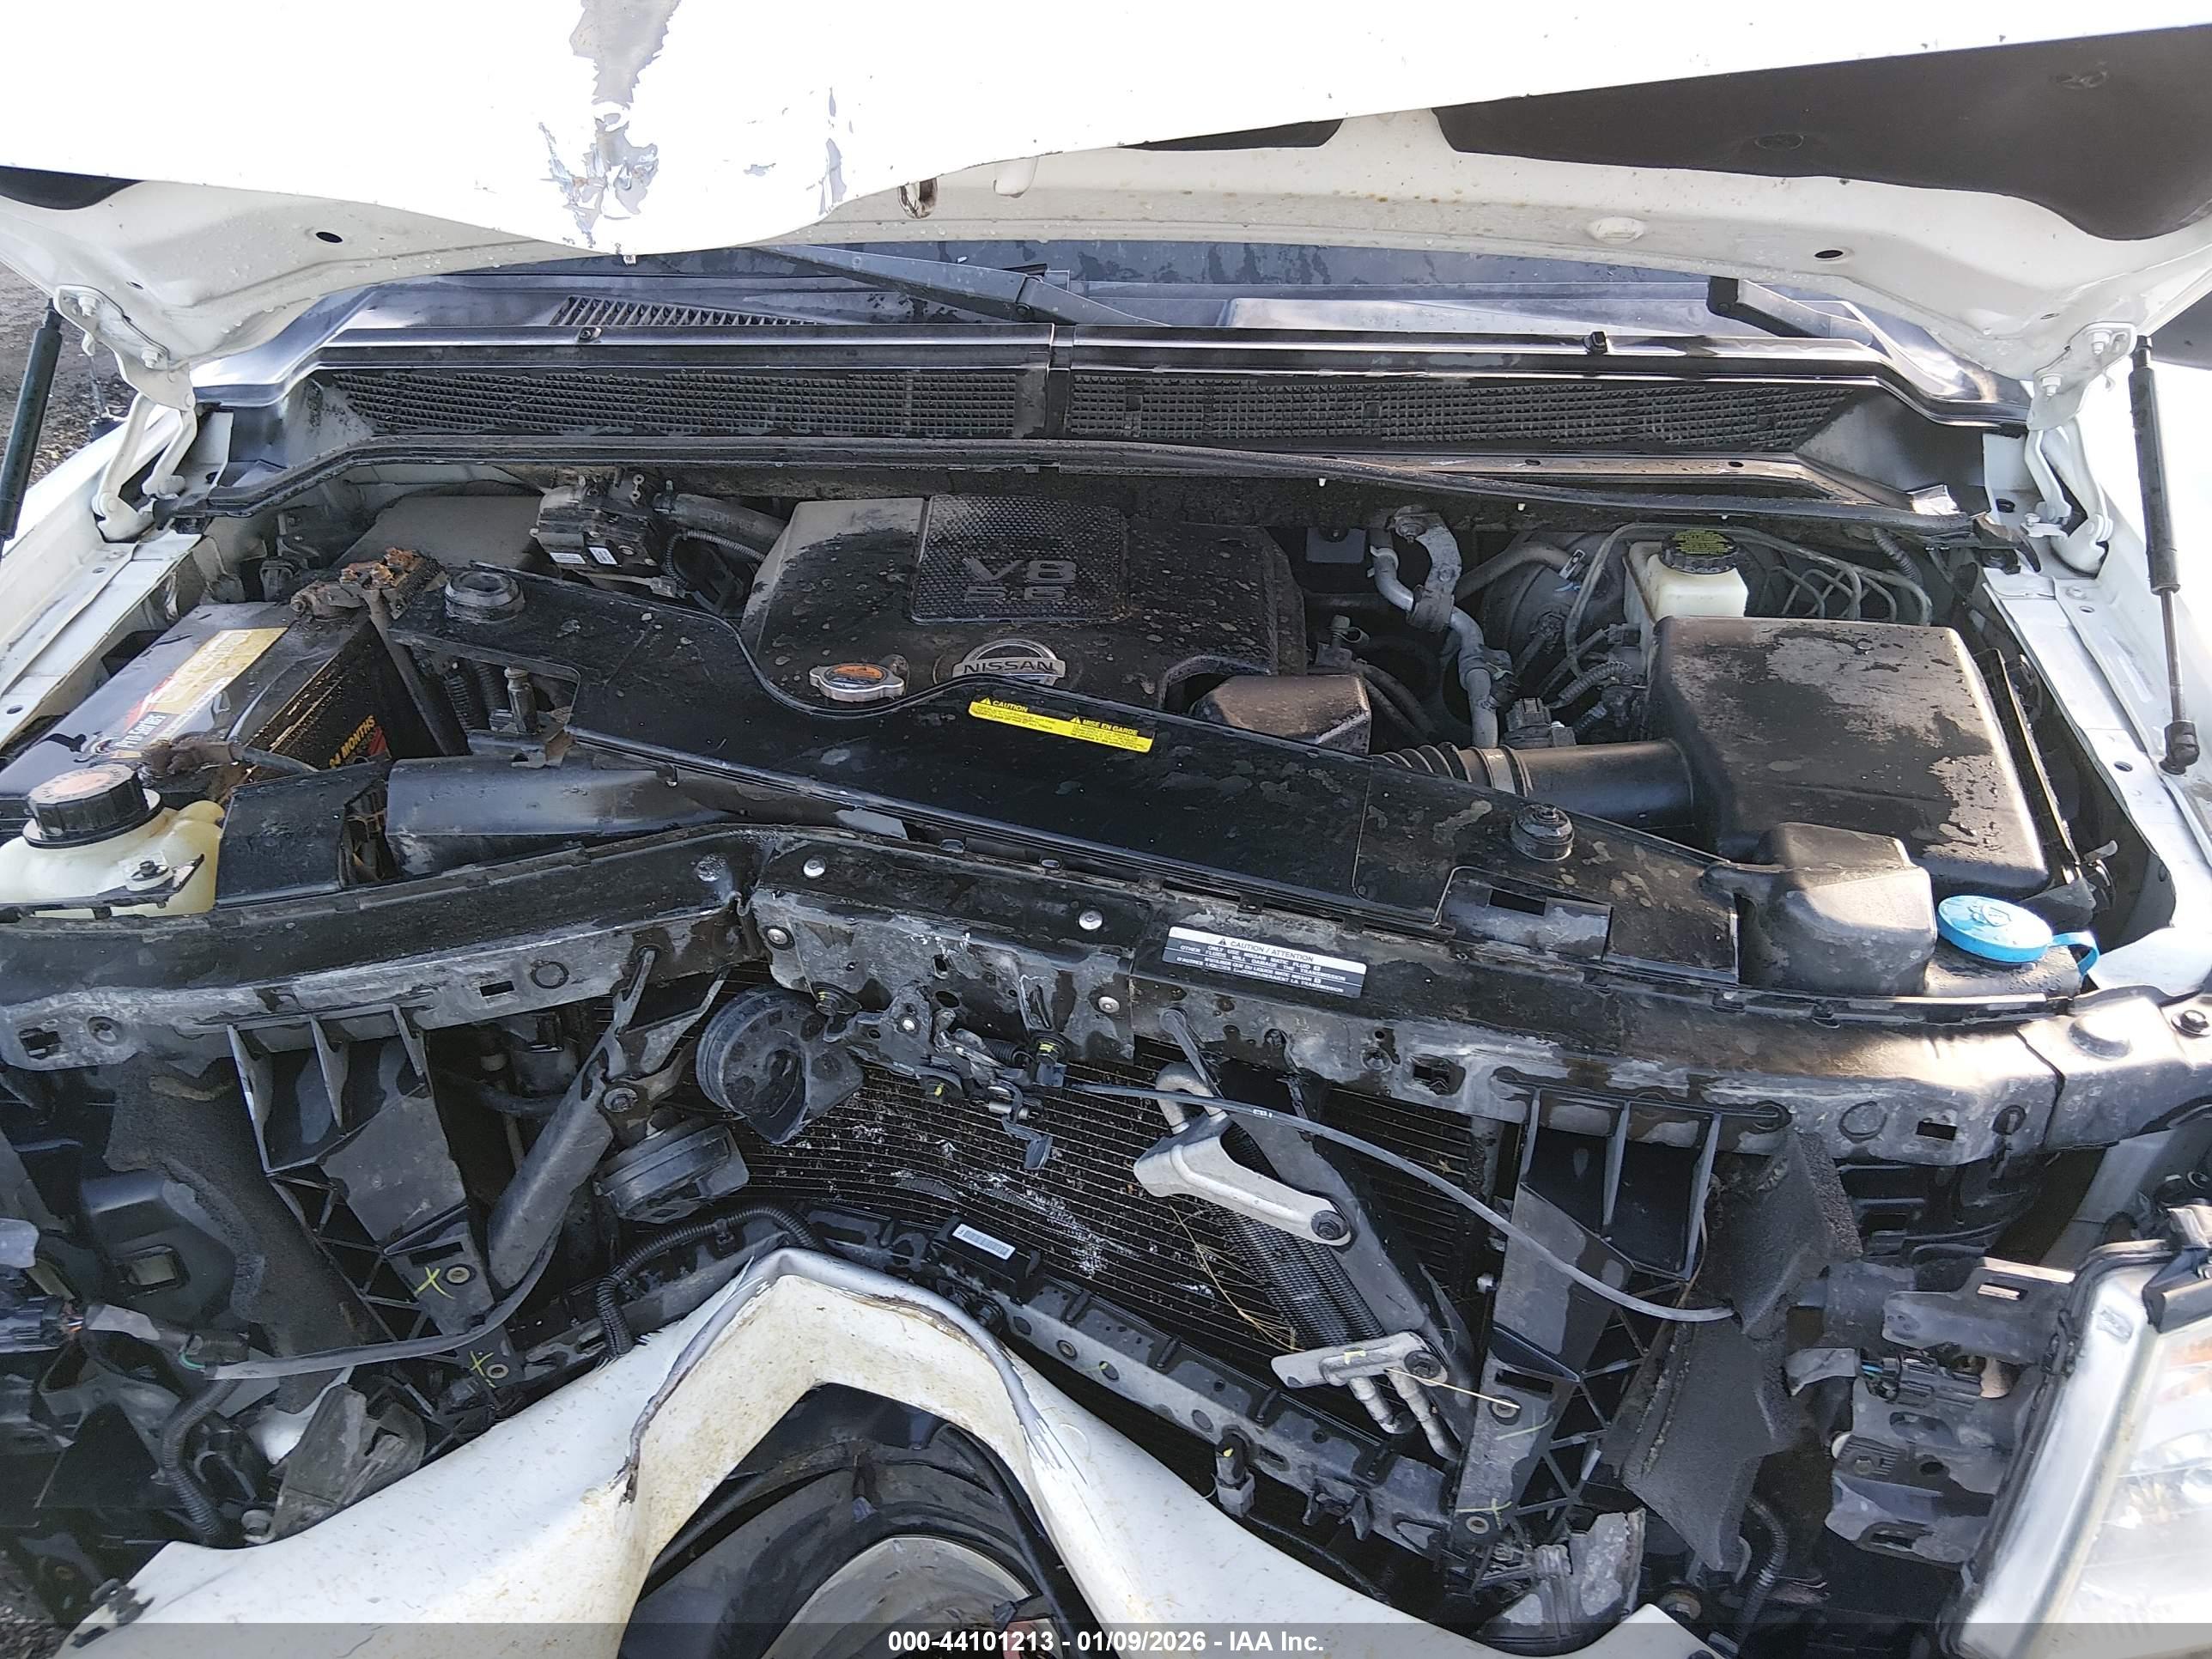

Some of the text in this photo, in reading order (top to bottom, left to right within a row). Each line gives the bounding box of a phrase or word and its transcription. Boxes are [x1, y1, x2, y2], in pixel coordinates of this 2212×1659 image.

[962, 558, 1076, 584] V8
[963, 660, 1054, 674] NISSAN
[992, 699, 1029, 714] CAUTION
[1082, 718, 1100, 728] MISE
[1111, 726, 1139, 737] GARDE
[1230, 940, 1264, 951] CAUTION
[1271, 949, 1313, 962] ATTENTION
